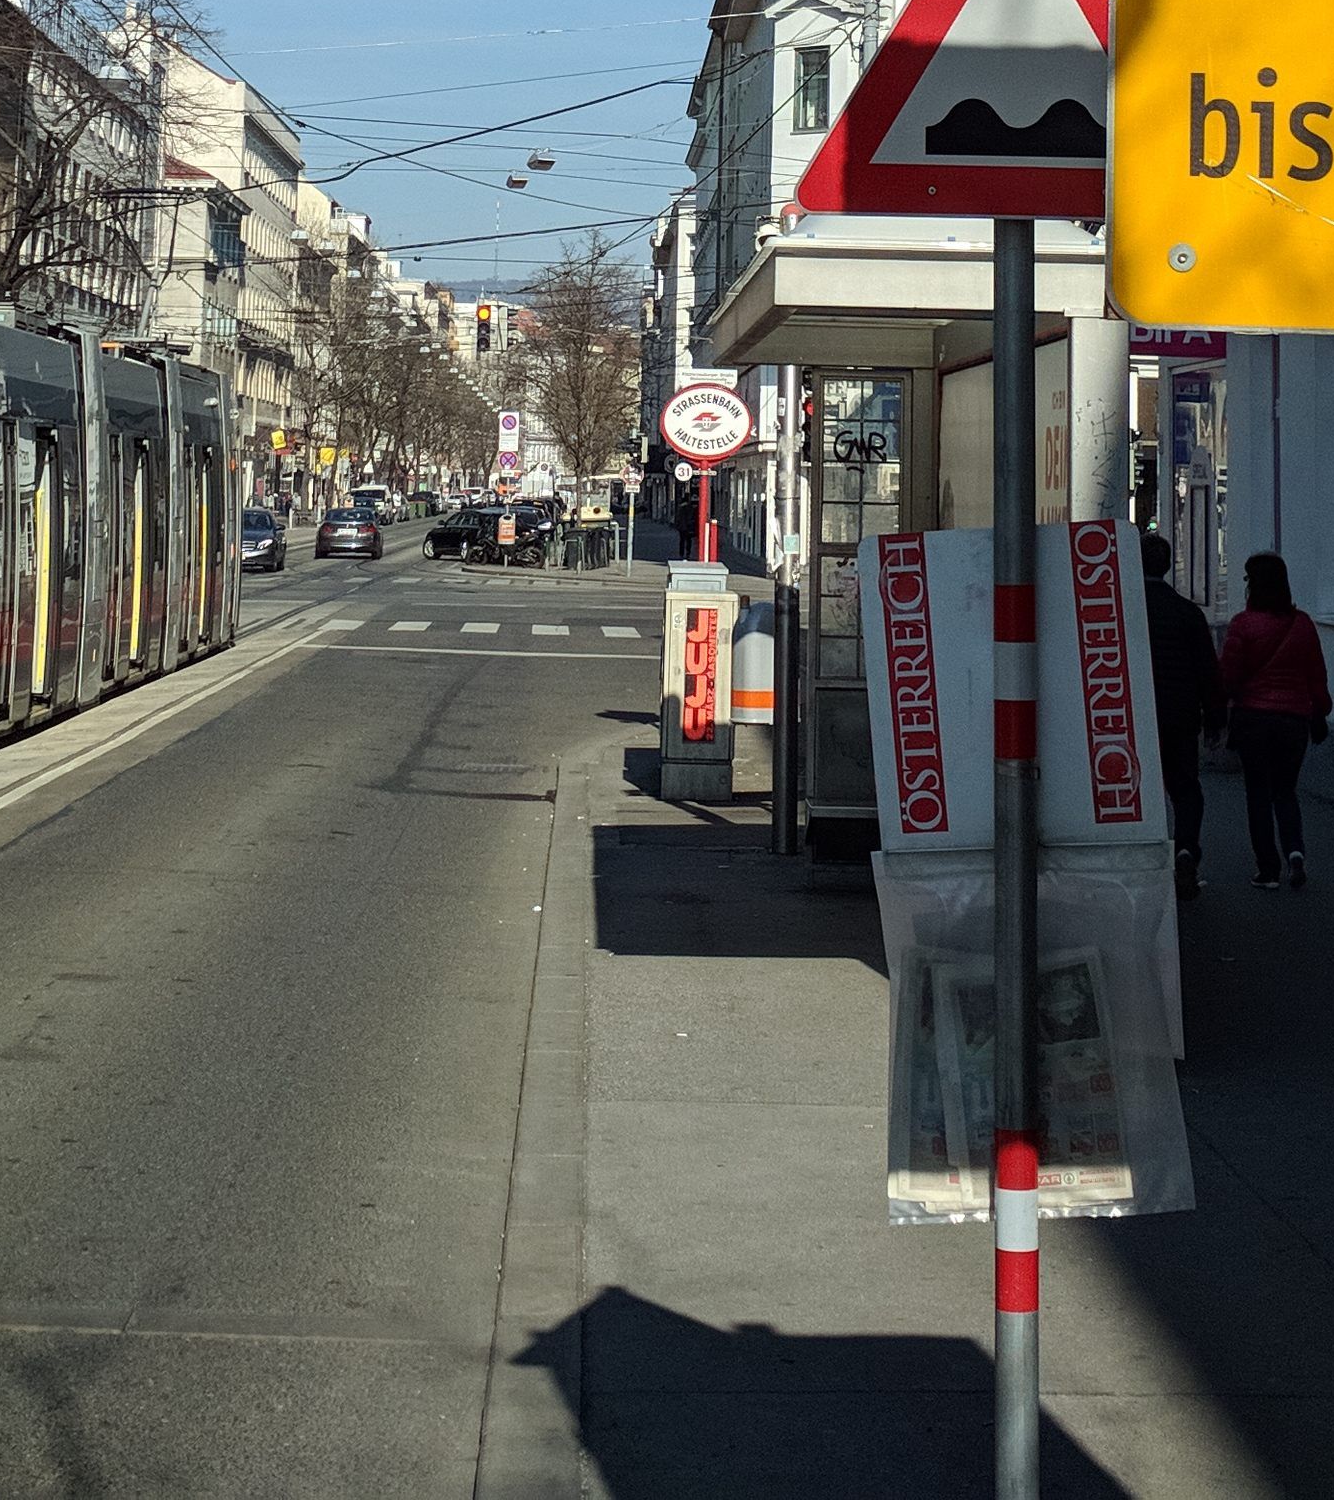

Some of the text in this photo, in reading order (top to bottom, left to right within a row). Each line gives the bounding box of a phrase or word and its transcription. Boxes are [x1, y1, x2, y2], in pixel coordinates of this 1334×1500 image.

[672, 393, 743, 419] STRASSENBAHN
[674, 427, 739, 450] HALTESTELLE
[677, 467, 690, 478] 31
[706, 609, 718, 680] GASOMETER
[884, 536, 943, 831] ÖSTERREICH
[1074, 523, 1136, 822] ÖSTERREICH
[1038, 1174, 1061, 1185] AR
